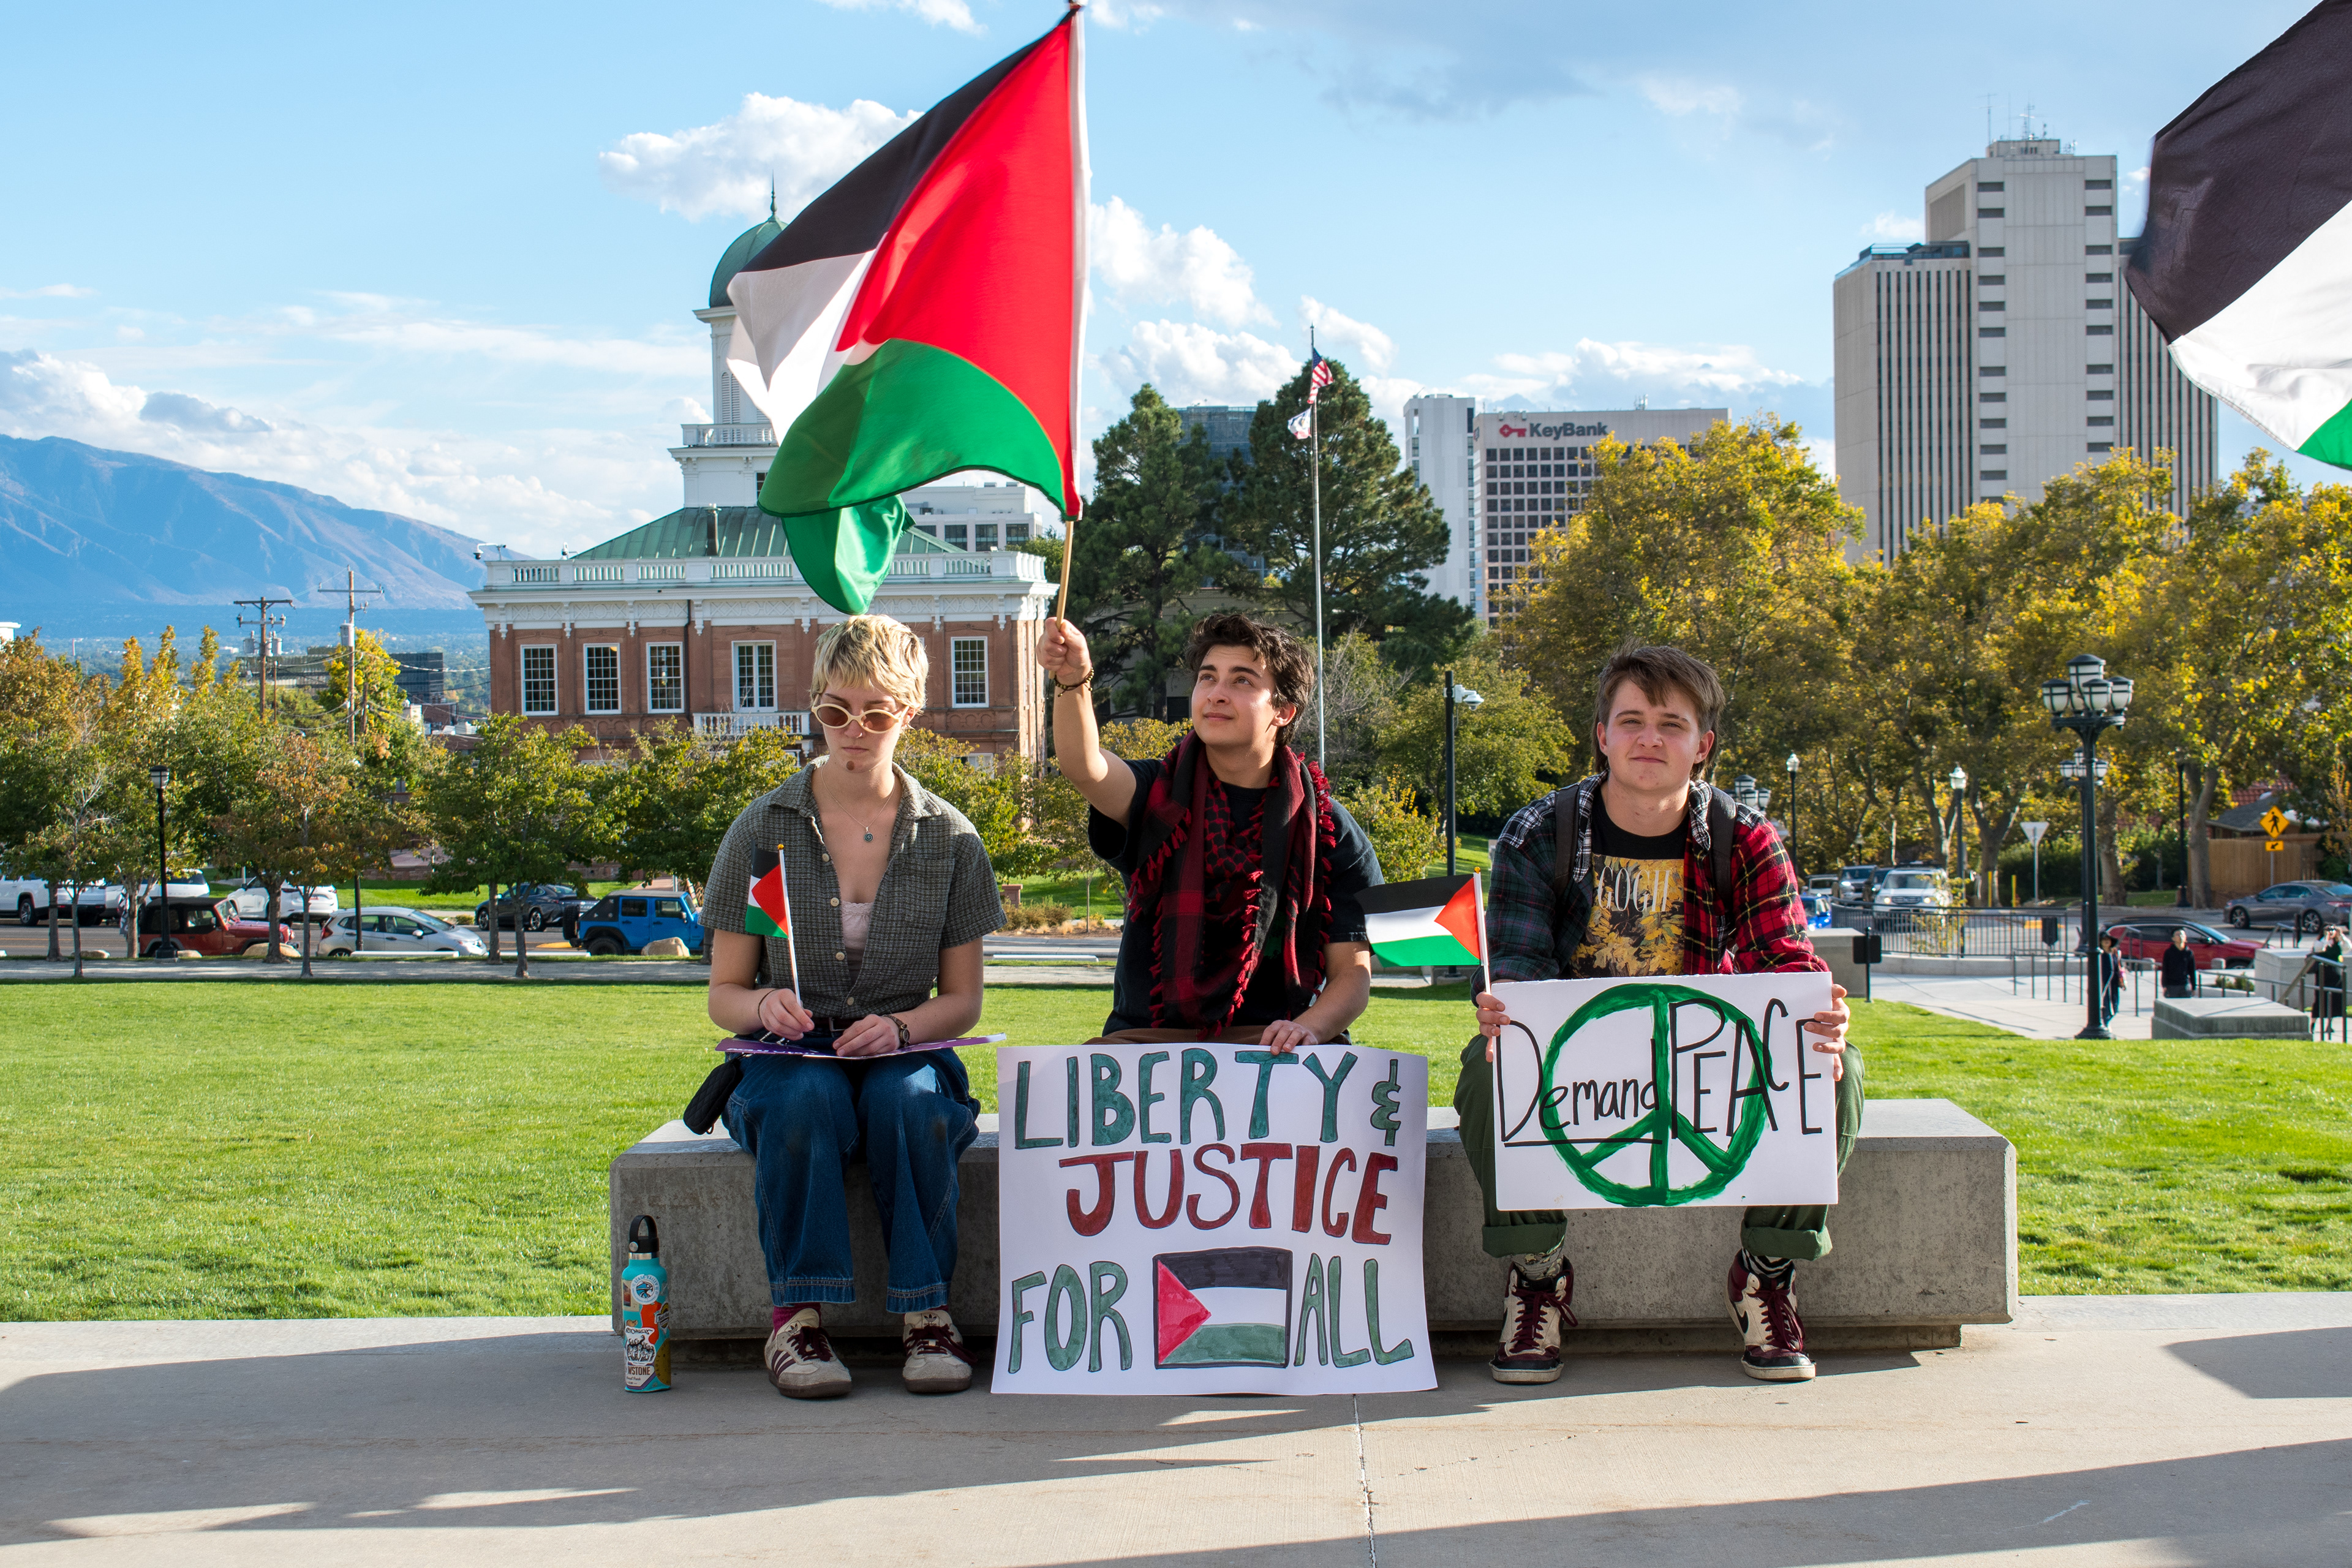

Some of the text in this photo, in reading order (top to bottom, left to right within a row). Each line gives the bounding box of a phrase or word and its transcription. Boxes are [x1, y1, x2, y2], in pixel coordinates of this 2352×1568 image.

[1529, 421, 1608, 440] KeyBank
[1597, 865, 1672, 912] GOGH
[1015, 1048, 1401, 1149] LIBERTY &
[1496, 998, 1832, 1142] Demand PEACE
[1059, 1143, 1398, 1245] JUSTICE
[1008, 1253, 1414, 1373] FOR ALL
